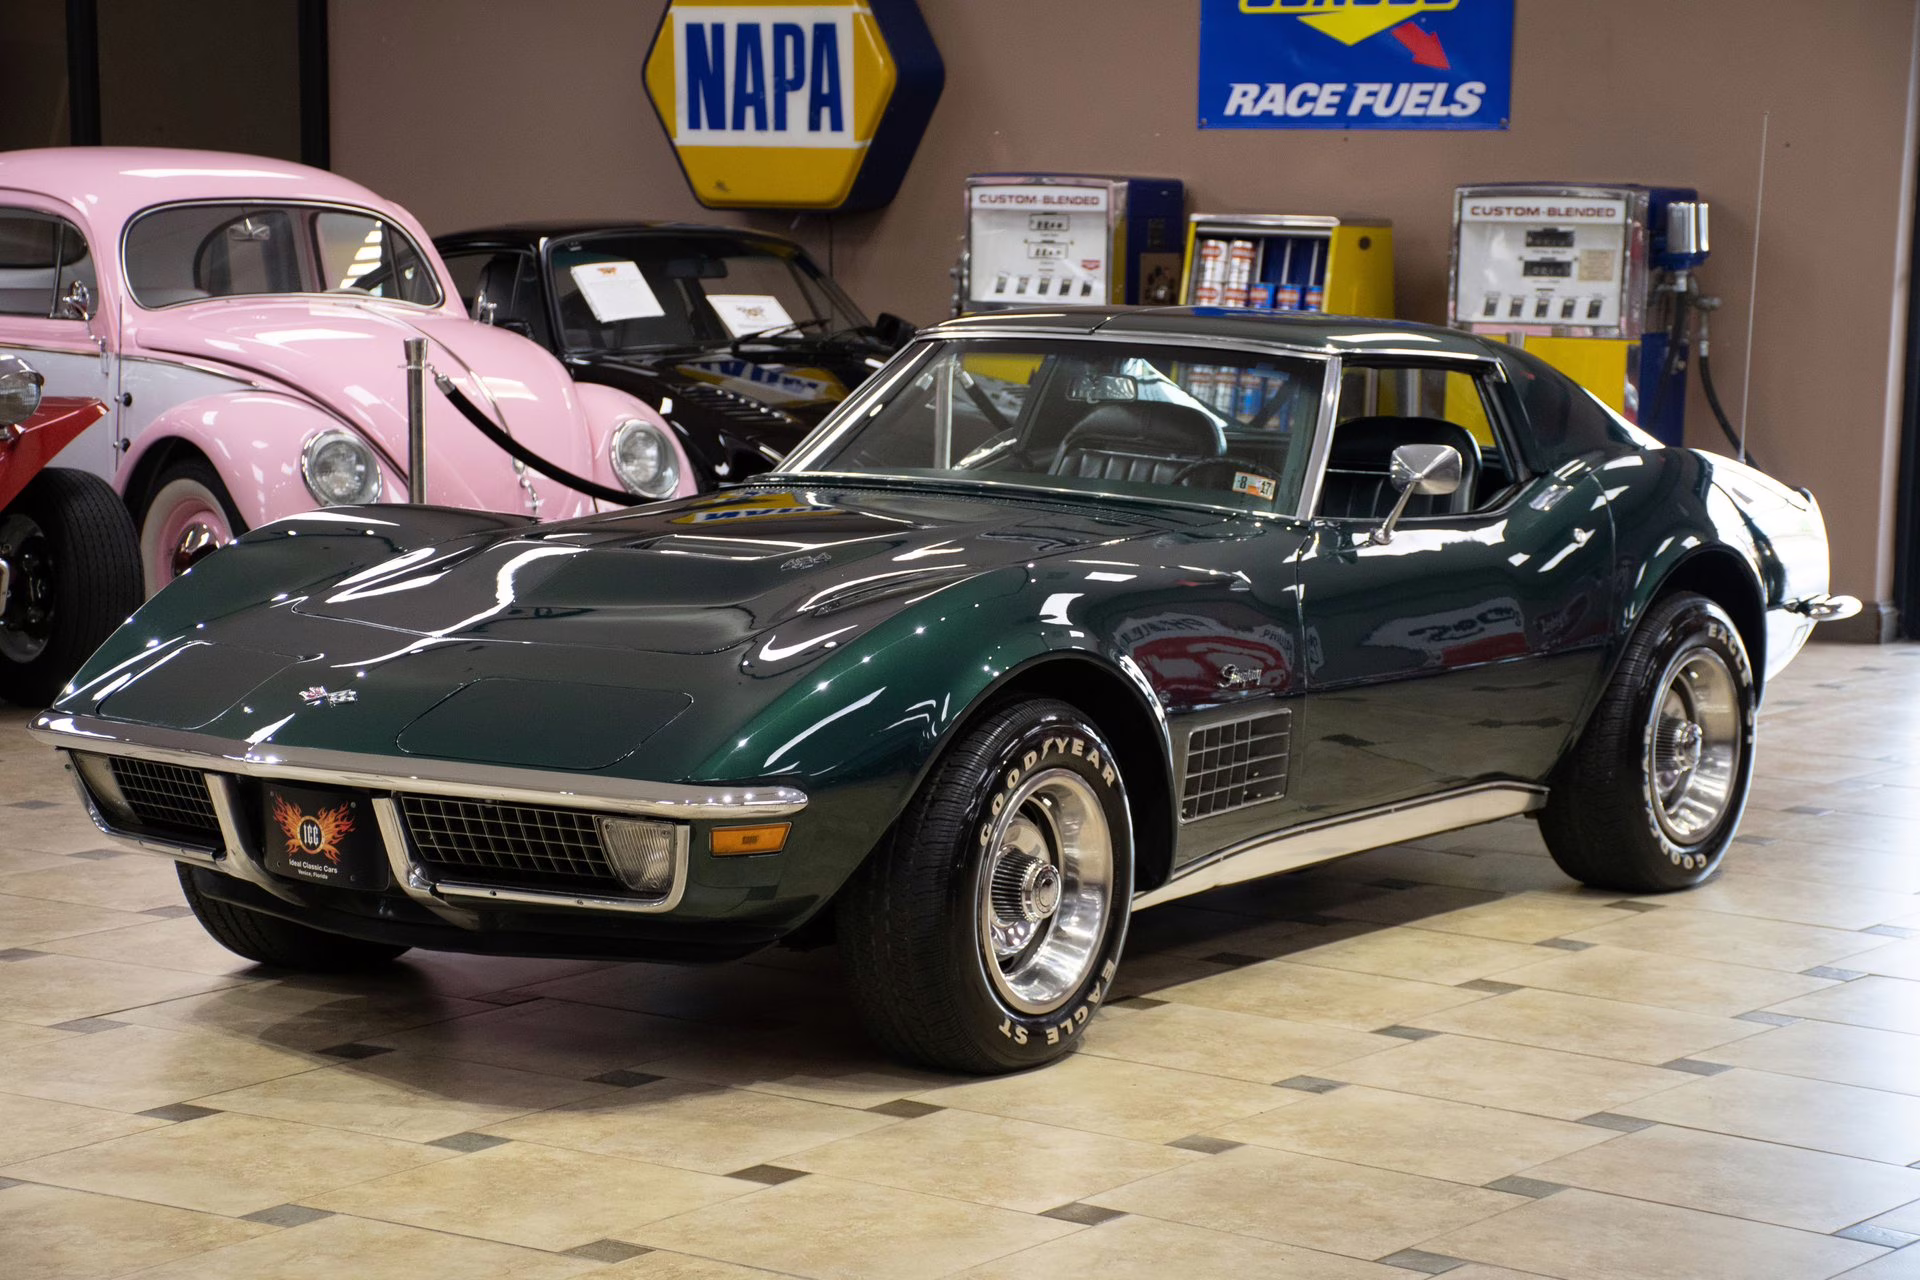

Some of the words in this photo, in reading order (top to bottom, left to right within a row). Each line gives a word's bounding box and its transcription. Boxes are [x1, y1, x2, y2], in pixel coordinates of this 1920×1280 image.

[685, 22, 844, 132] NAPA
[1223, 83, 1347, 117] RACE
[1346, 81, 1487, 117] FUELS
[979, 194, 1037, 204] CUSTOM
[1042, 195, 1101, 205] BLENDED
[980, 737, 1116, 847] GOODYEAR
[288, 859, 302, 868] Ideal
[302, 861, 322, 871] Classic
[323, 865, 338, 874] Cars
[1045, 959, 1117, 1046] EAGLE
[998, 1017, 1029, 1046] ST
